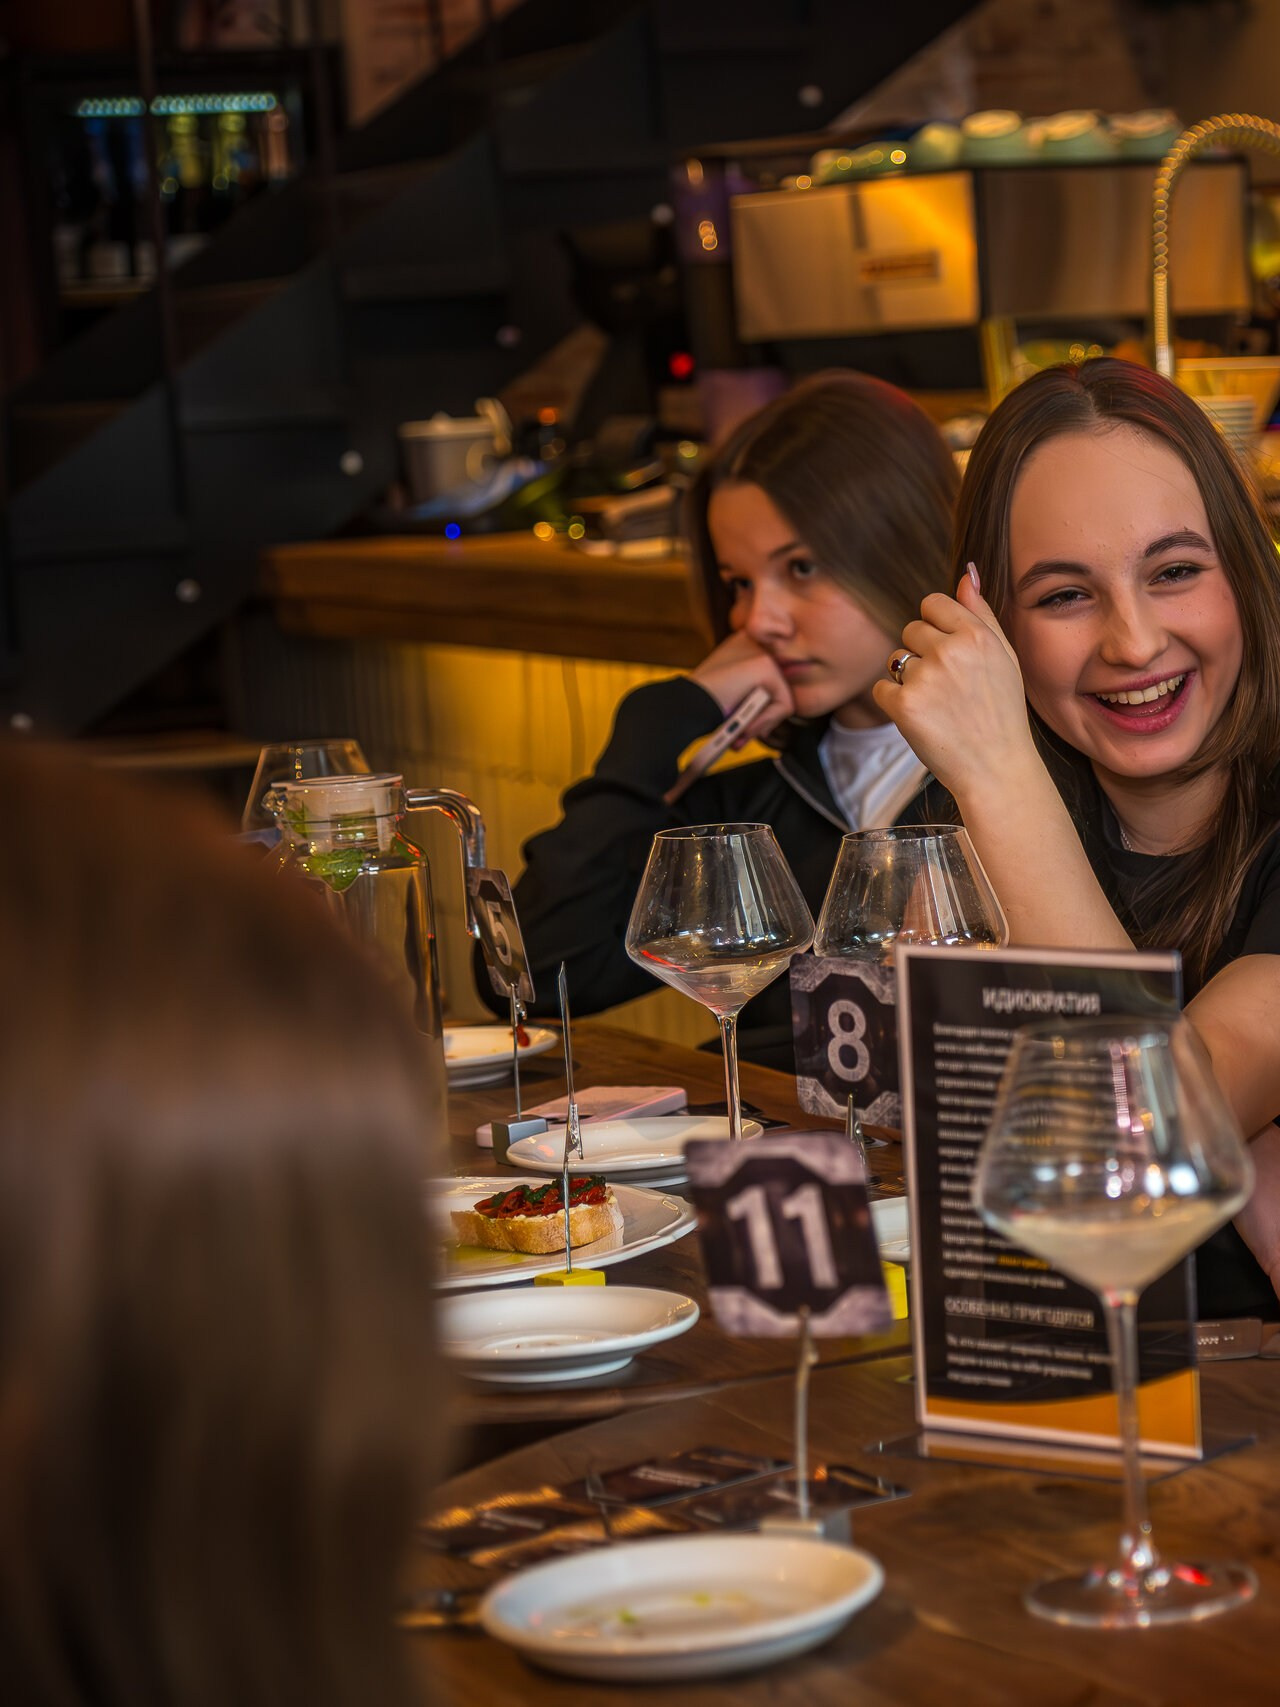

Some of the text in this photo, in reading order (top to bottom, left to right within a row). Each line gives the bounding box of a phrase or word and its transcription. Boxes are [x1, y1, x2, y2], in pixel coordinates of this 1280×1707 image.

[486, 901, 512, 966] 5
[827, 999, 870, 1083] 8
[727, 1184, 839, 1290] 11
